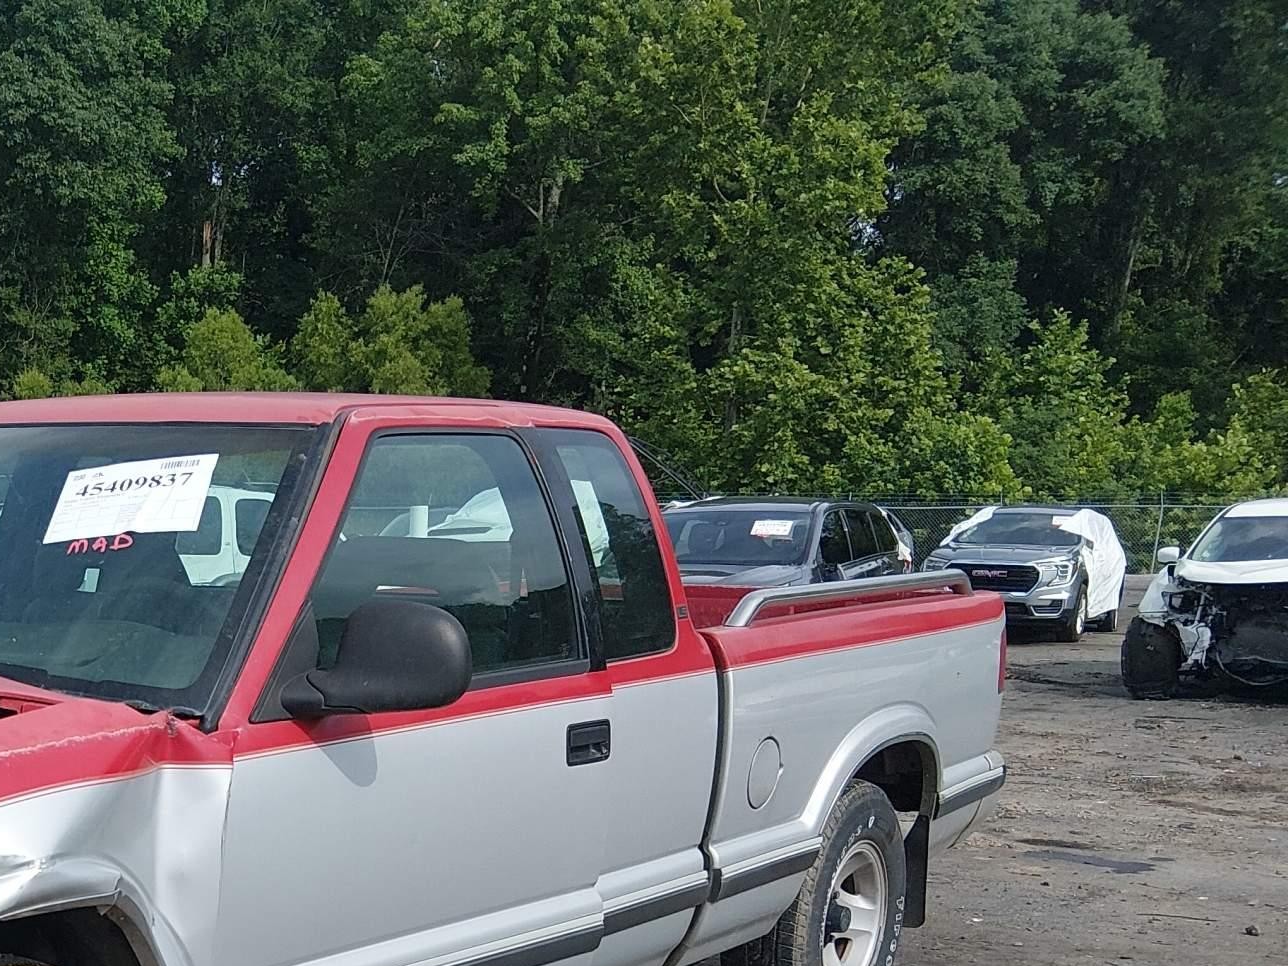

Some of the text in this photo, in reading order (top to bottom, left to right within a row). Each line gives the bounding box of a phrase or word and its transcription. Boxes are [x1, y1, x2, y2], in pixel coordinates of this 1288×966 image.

[75, 471, 193, 497] 45409837
[66, 533, 134, 555] MAD
[971, 569, 1008, 579] GMC
